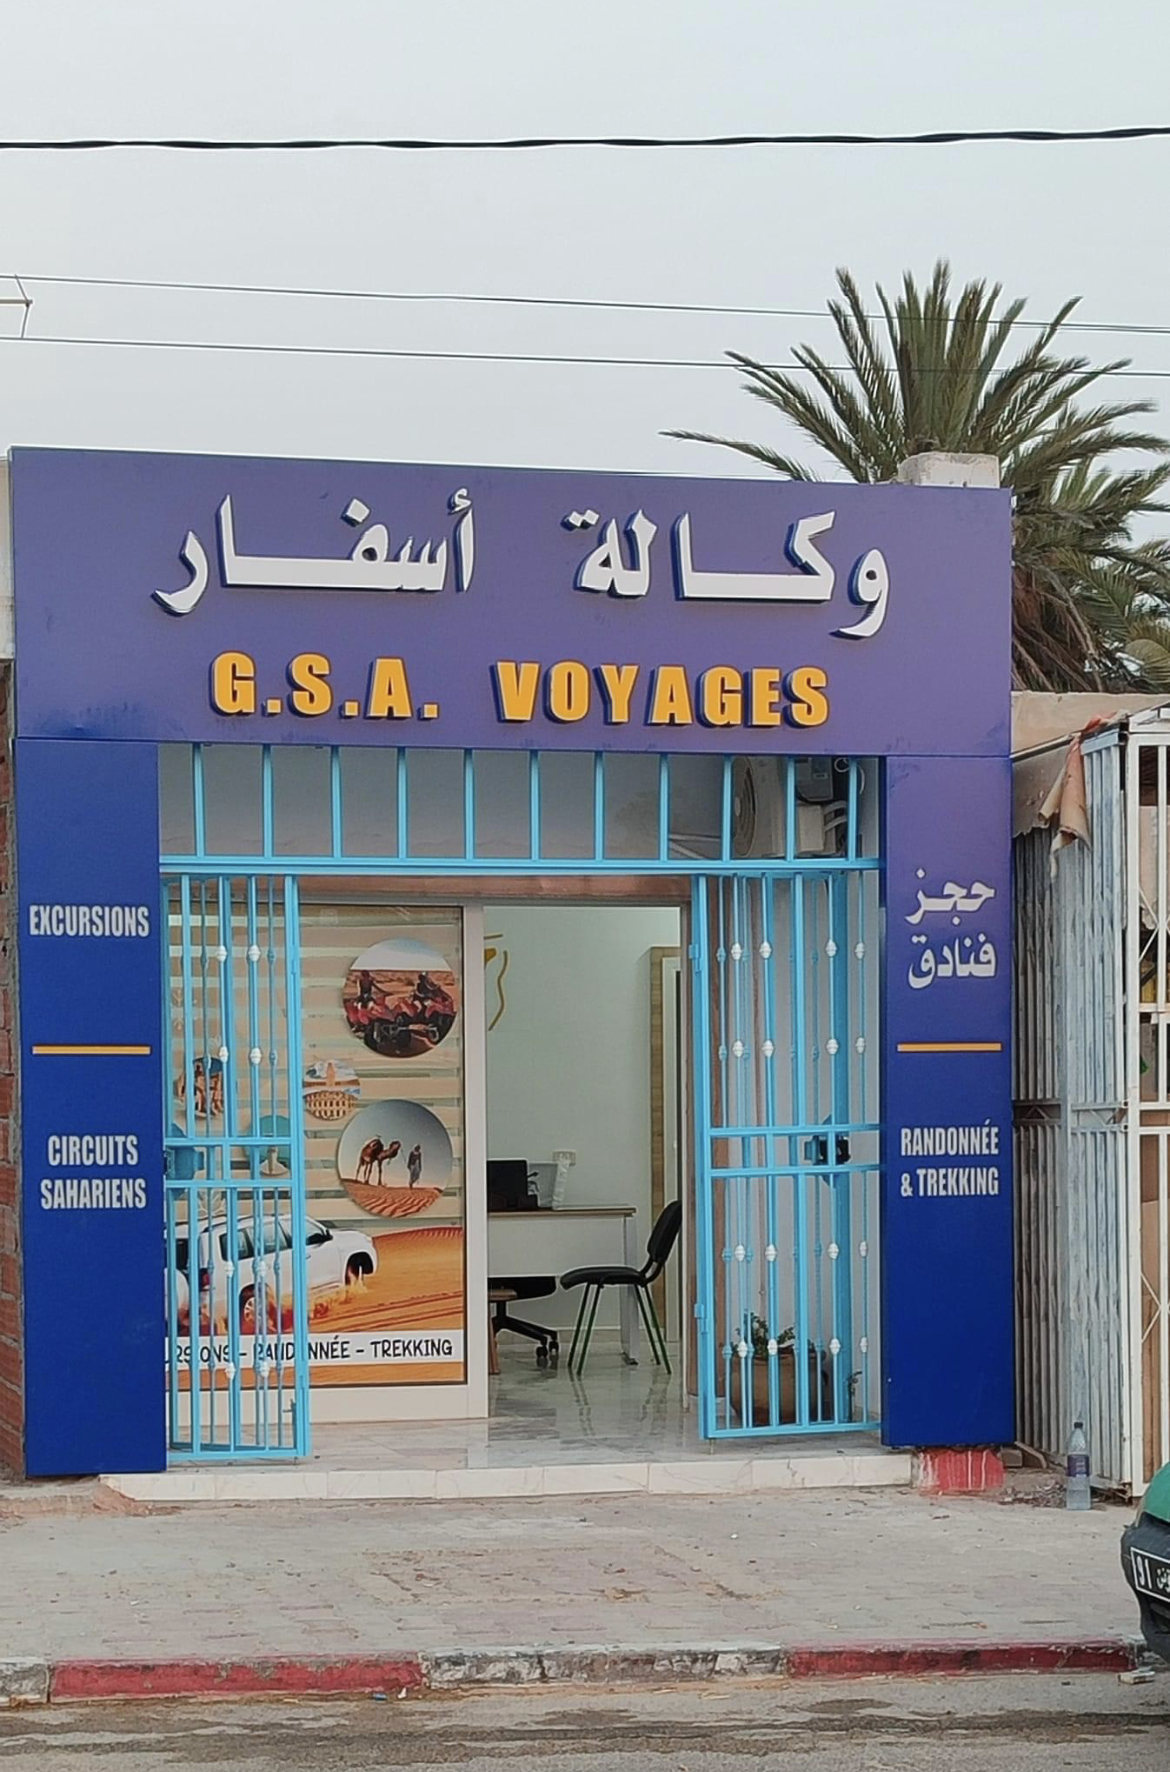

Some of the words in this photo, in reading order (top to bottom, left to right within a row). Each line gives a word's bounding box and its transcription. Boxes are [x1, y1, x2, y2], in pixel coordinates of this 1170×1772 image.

[154, 487, 475, 614] أسفار
[564, 509, 889, 637] وكالة
[213, 651, 439, 719] G.S.A.
[497, 660, 830, 728] VOYAGES
[905, 868, 996, 925] حجز
[29, 904, 149, 938] EXCURSIONS
[908, 933, 996, 989] فنادق
[48, 1135, 138, 1166] CIRCUITS
[901, 1119, 998, 1156] RANDONNÉE
[41, 1178, 147, 1209] SAHARIENS
[901, 1172, 912, 1197] &
[917, 1167, 998, 1197] TREKKING
[370, 1339, 453, 1358] TREKKING
